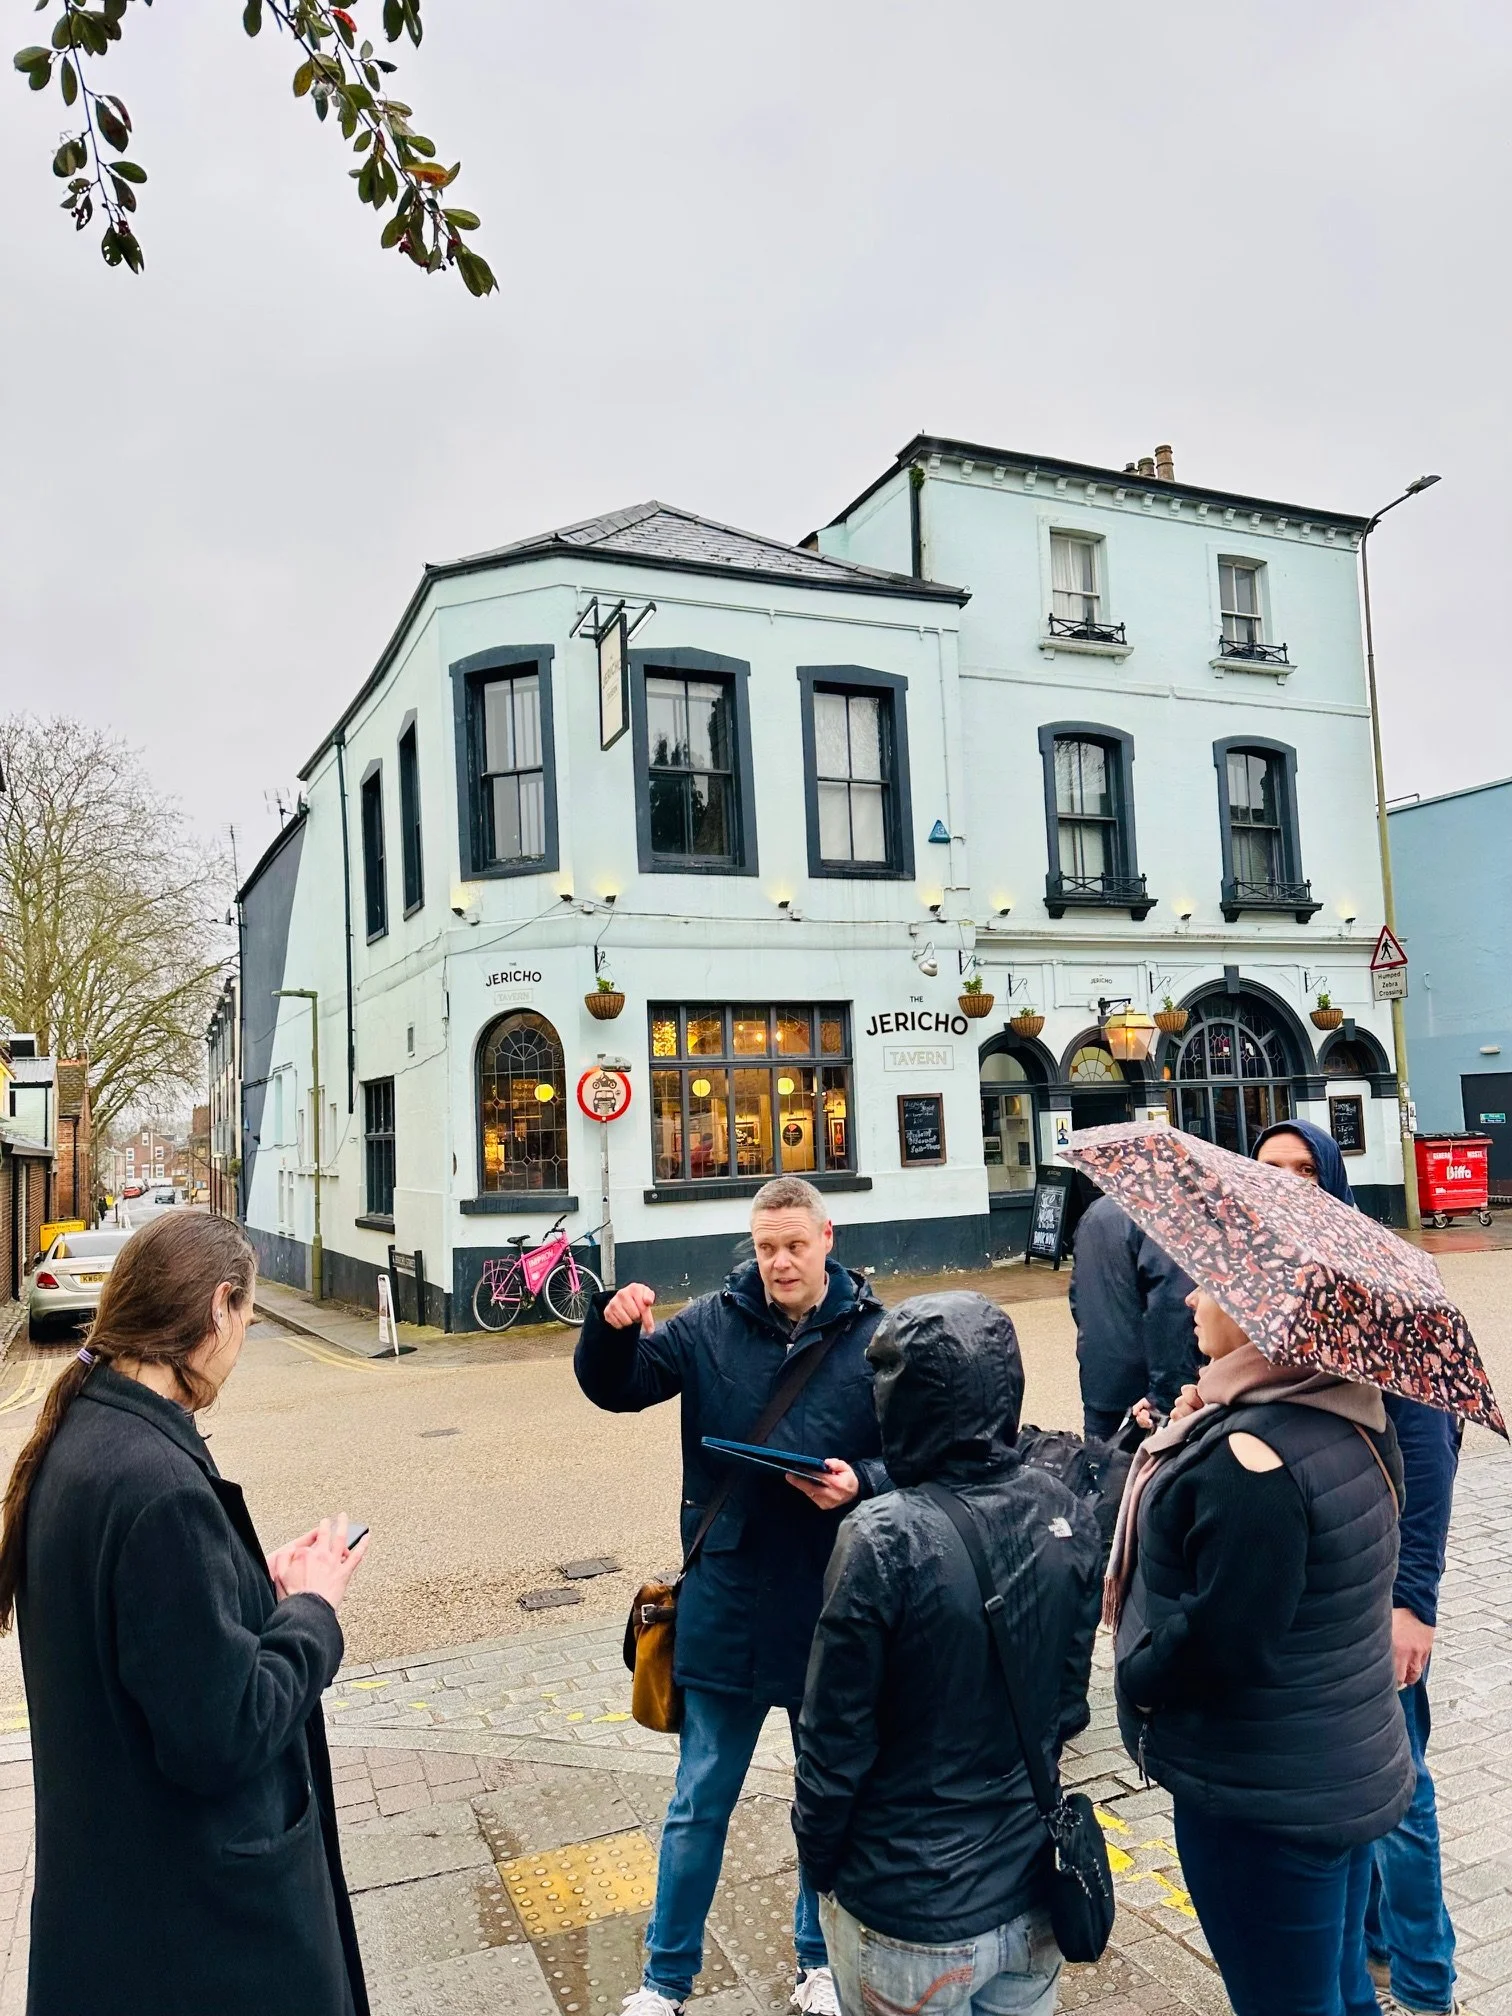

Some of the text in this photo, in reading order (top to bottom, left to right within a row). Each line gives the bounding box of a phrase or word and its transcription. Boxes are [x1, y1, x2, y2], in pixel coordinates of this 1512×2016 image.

[485, 970, 542, 987] JERICHO
[1377, 971, 1401, 980] Humped
[1382, 981, 1398, 989] Zebra
[497, 991, 530, 1002] TAVERN
[1378, 988, 1403, 997] Crossing
[909, 995, 924, 1003] THE
[866, 1011, 968, 1036] JERICHO
[889, 1050, 948, 1066] TAVERN
[1446, 1164, 1472, 1180] Biffa
